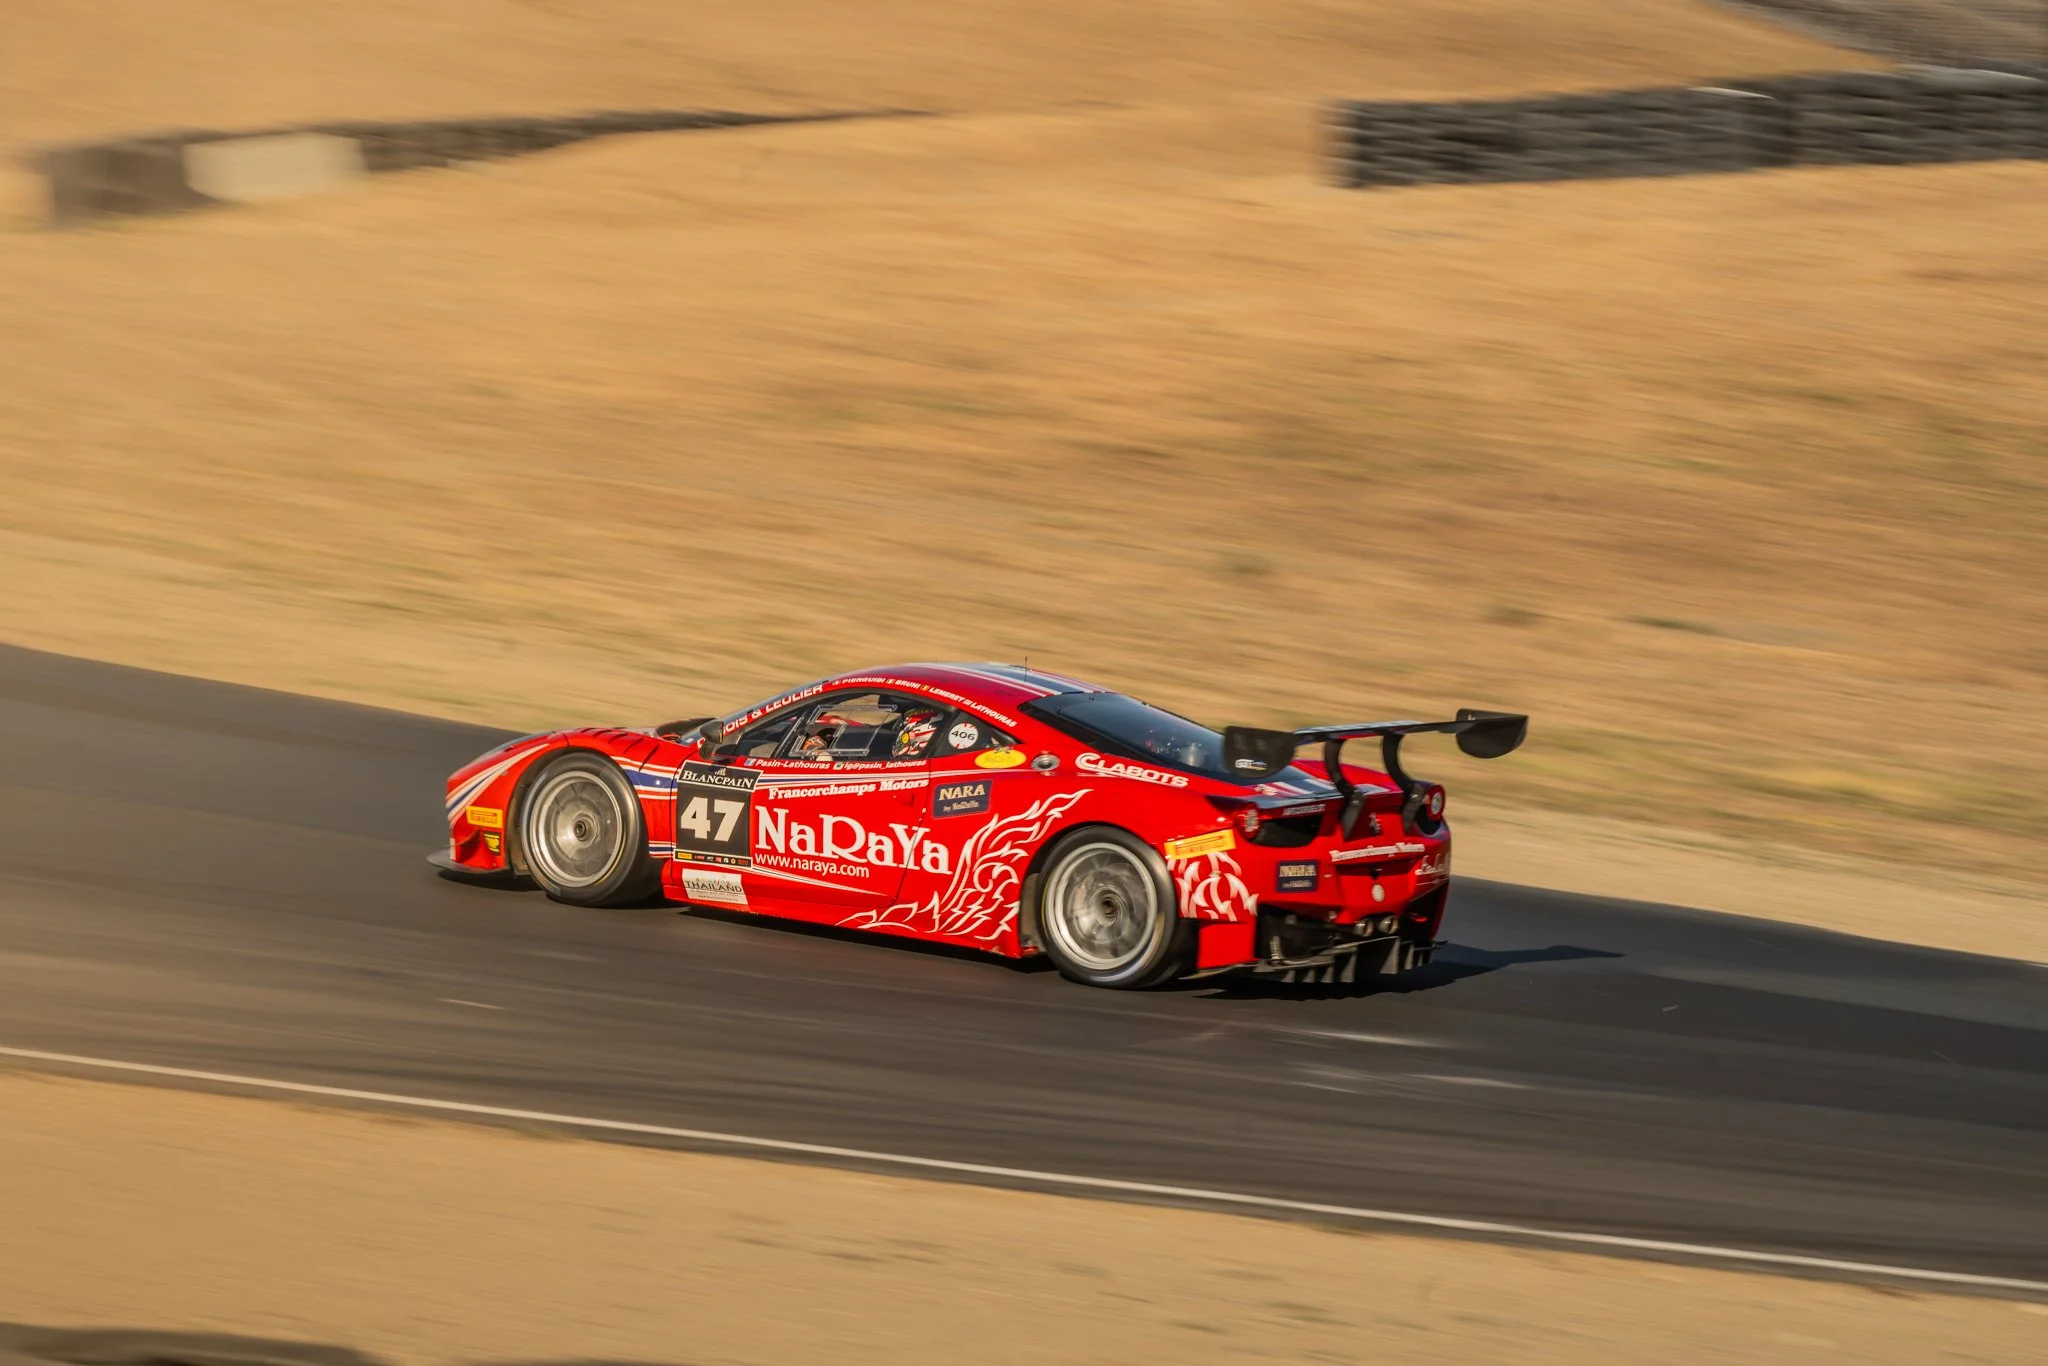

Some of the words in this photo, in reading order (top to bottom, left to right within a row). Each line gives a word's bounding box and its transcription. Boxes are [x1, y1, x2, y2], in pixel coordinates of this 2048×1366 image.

[894, 679, 920, 689] BRUNI
[951, 730, 976, 741] 406
[755, 759, 831, 770] Pasin-Lathouras
[1075, 753, 1189, 788] CLABOTS
[682, 771, 754, 789] BLANCPAIN
[768, 783, 875, 800] Francorchamps
[878, 778, 929, 792] Motors
[938, 784, 986, 801] NARA
[681, 796, 745, 842] 47
[755, 805, 953, 875] NaRaYa
[755, 852, 870, 878] www.naraya.com
[685, 880, 742, 893] THAILAND
